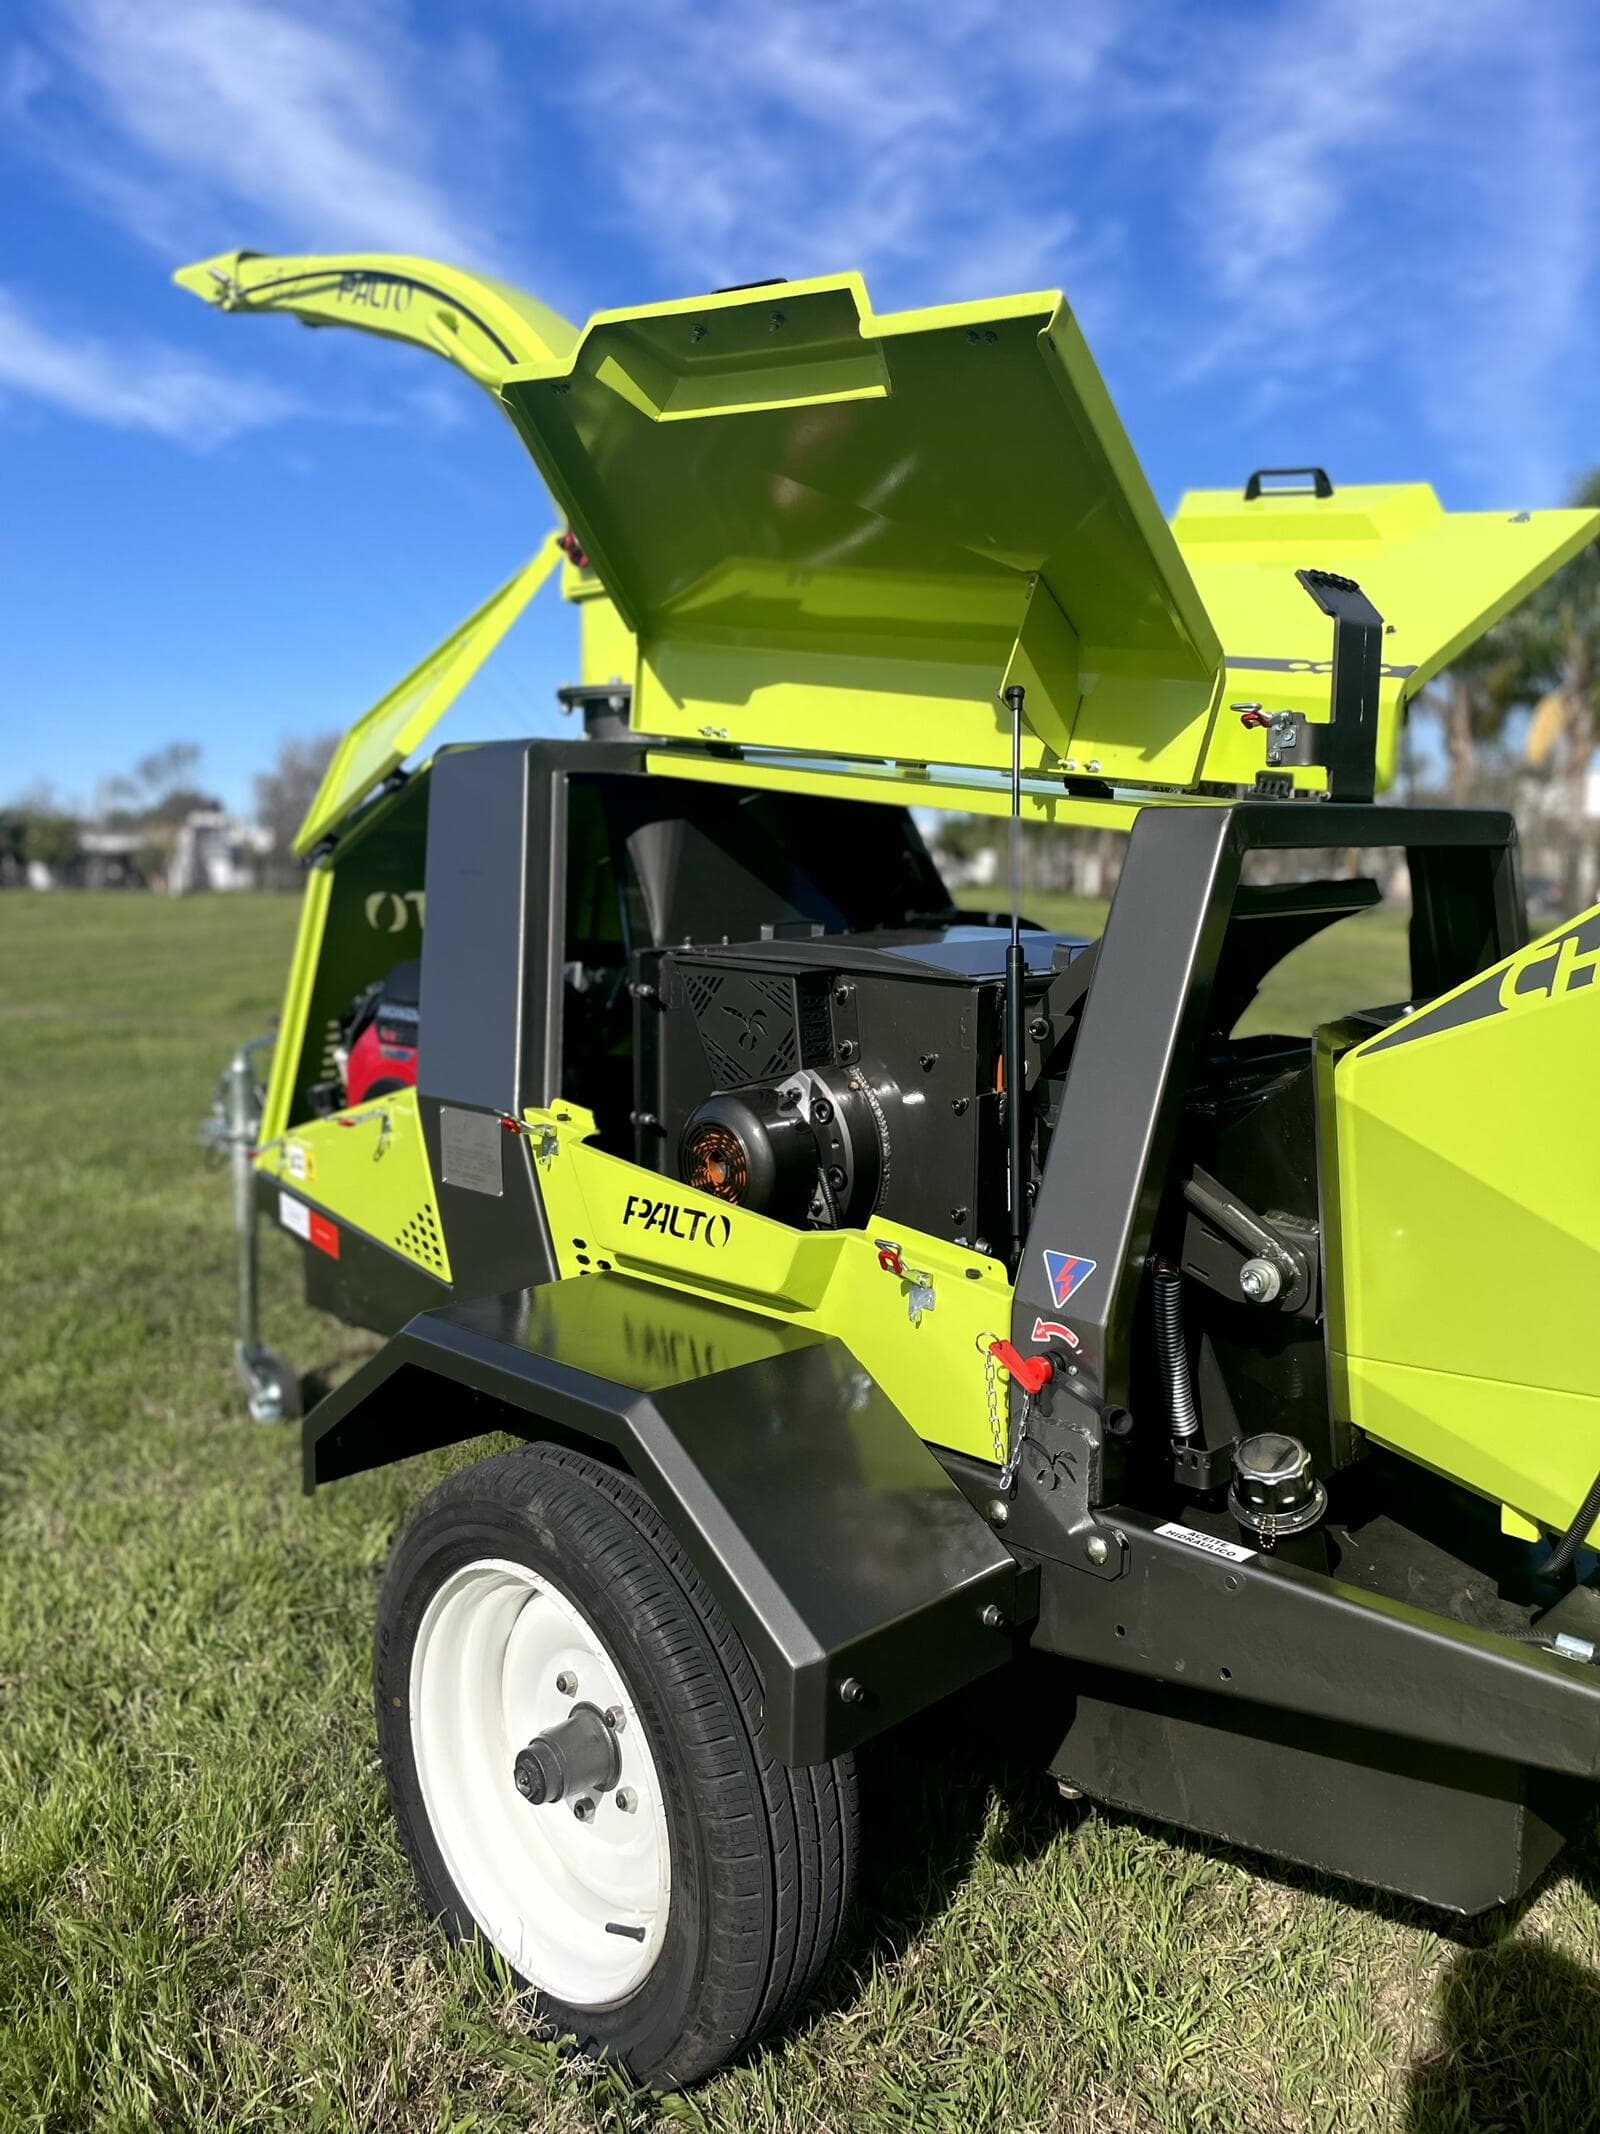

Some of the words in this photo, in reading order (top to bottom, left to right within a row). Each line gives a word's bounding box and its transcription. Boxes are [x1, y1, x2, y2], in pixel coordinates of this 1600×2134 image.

[623, 1195, 731, 1248] PALTO
[1165, 1530, 1237, 1557] HIDRAULICO
[1187, 1531, 1230, 1548] ACEITE
